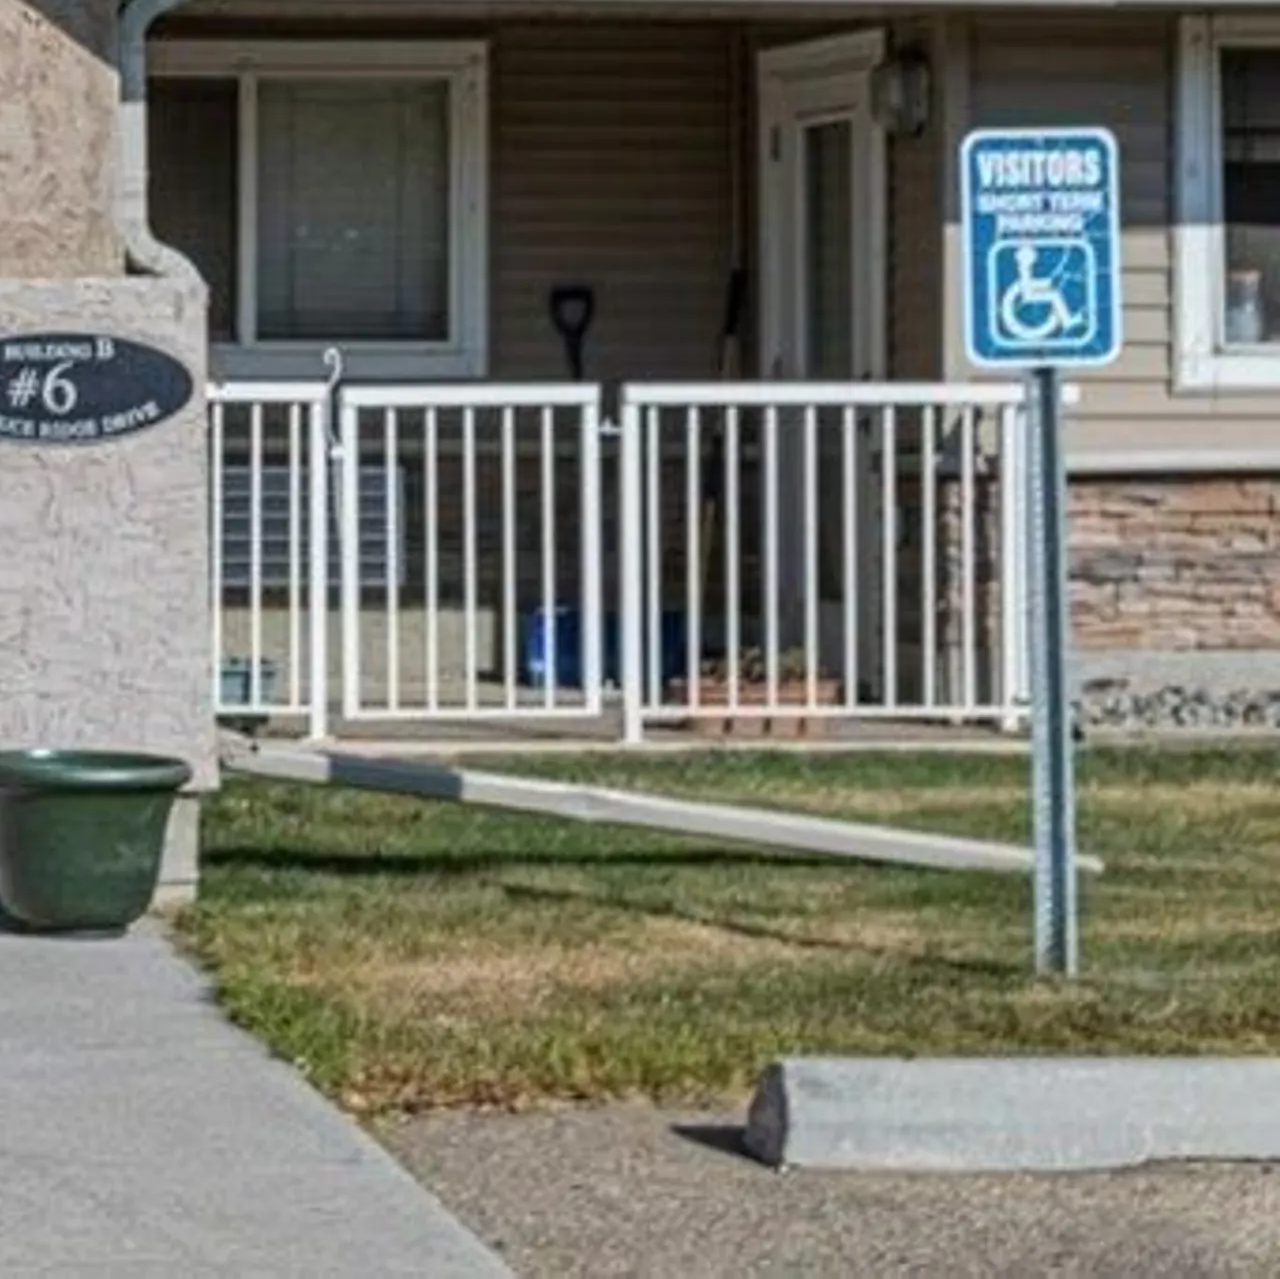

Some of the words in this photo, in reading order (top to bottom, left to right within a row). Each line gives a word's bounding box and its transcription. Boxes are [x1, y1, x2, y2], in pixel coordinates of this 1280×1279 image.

[976, 149, 1102, 187] VISITORS
[3, 343, 92, 361] BUILDING
[96, 338, 115, 359] B
[7, 360, 78, 415] #6
